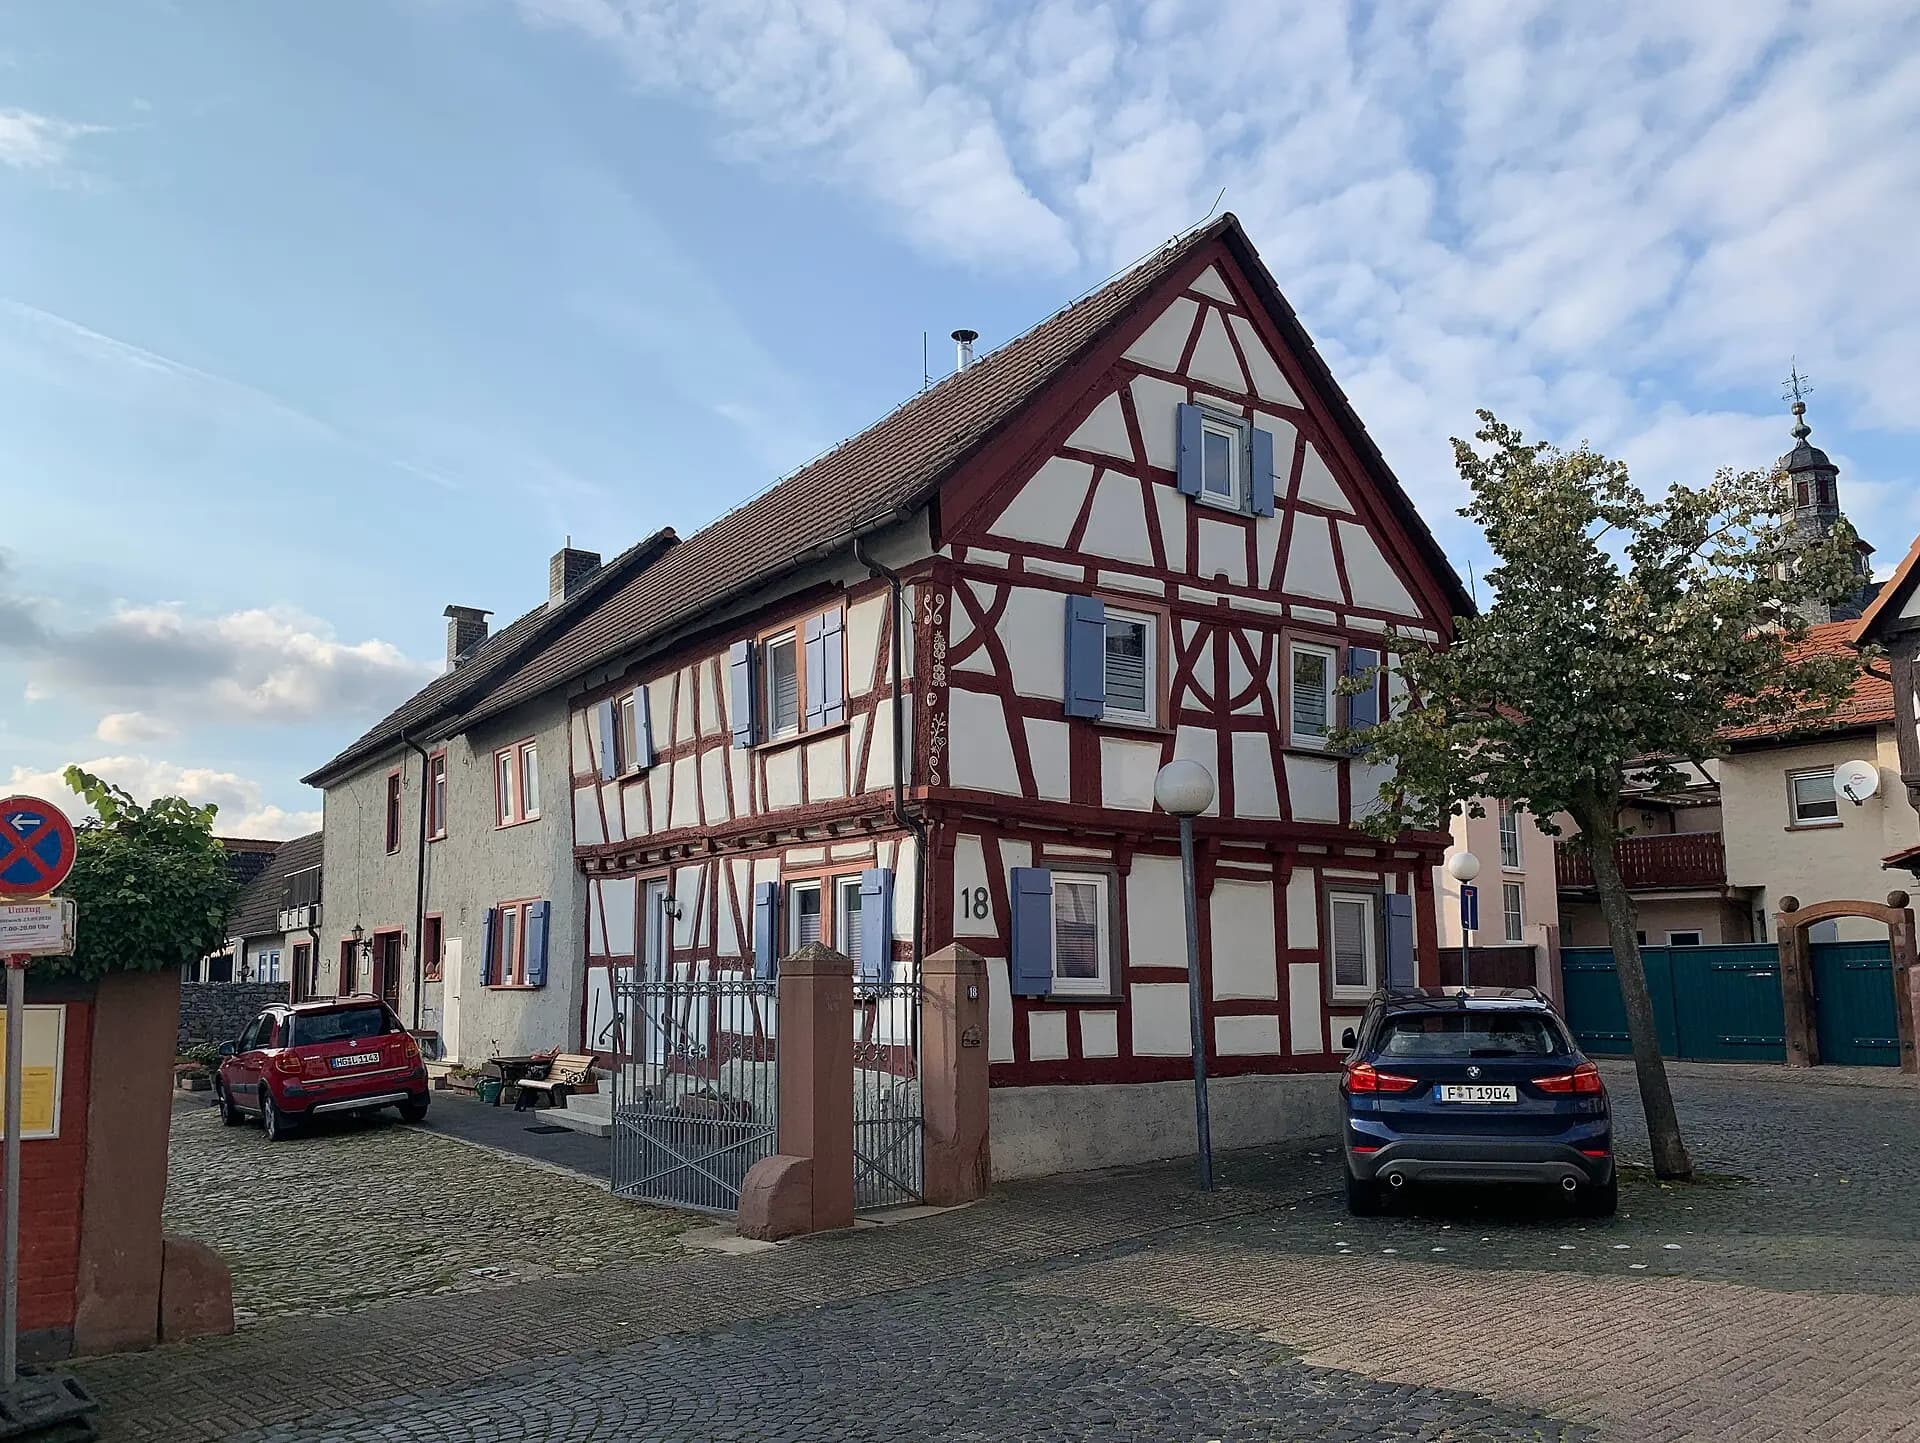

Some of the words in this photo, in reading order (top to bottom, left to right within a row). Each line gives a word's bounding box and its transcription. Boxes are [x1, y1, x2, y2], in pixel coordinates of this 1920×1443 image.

[962, 886, 988, 919] 18
[8, 906, 41, 914] Umzug
[969, 985, 978, 999] 18
[359, 1054, 378, 1063] 1143
[1447, 1087, 1456, 1099] F
[1465, 1087, 1474, 1100] T
[1476, 1087, 1511, 1100] 1904
